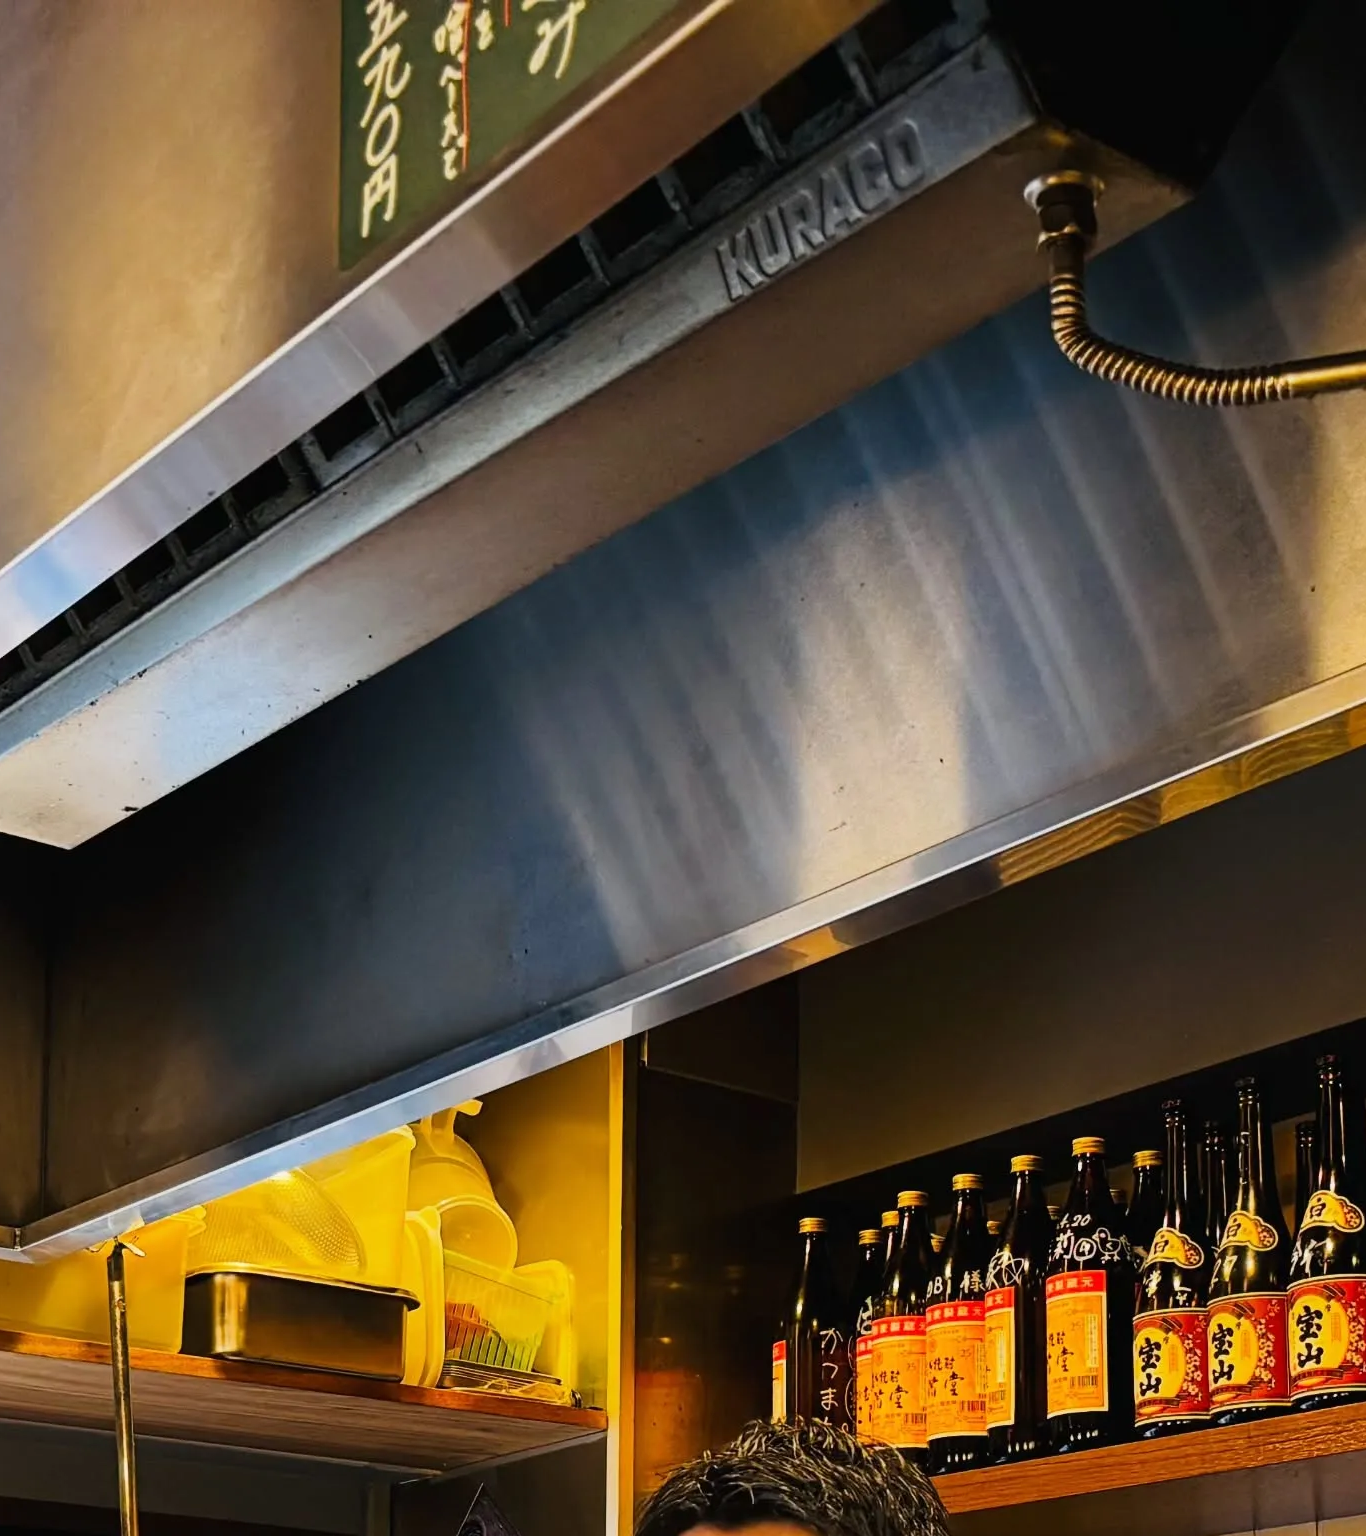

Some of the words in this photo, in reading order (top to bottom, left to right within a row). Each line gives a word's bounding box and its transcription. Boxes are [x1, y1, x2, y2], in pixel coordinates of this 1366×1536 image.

[1138, 1336, 1163, 1397] 宝山
[1211, 1323, 1235, 1384] 宝山
[1296, 1305, 1325, 1369] 宝山
